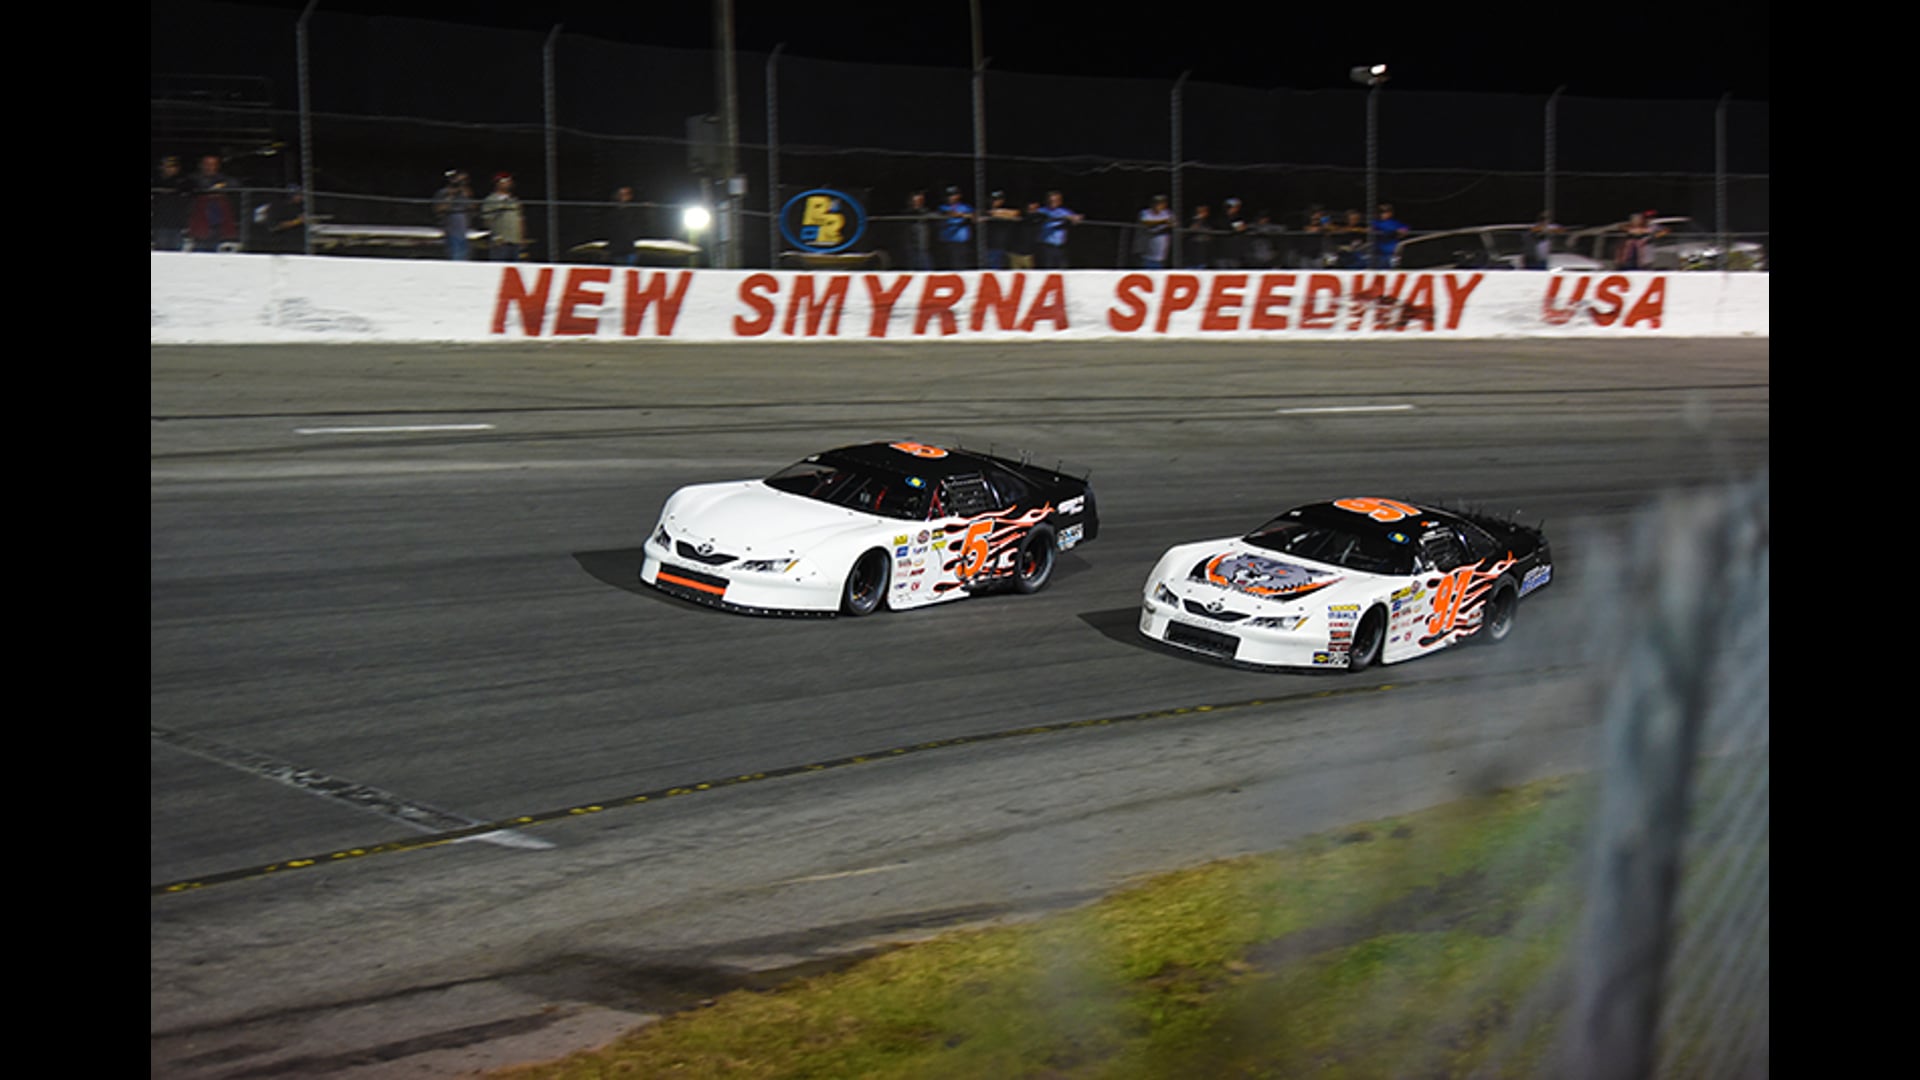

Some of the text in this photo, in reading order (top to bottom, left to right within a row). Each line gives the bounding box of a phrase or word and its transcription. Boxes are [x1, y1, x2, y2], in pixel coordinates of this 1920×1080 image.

[492, 266, 1667, 338] NEW SMYRNA SPEEDWAY USA
[955, 518, 995, 580] 5
